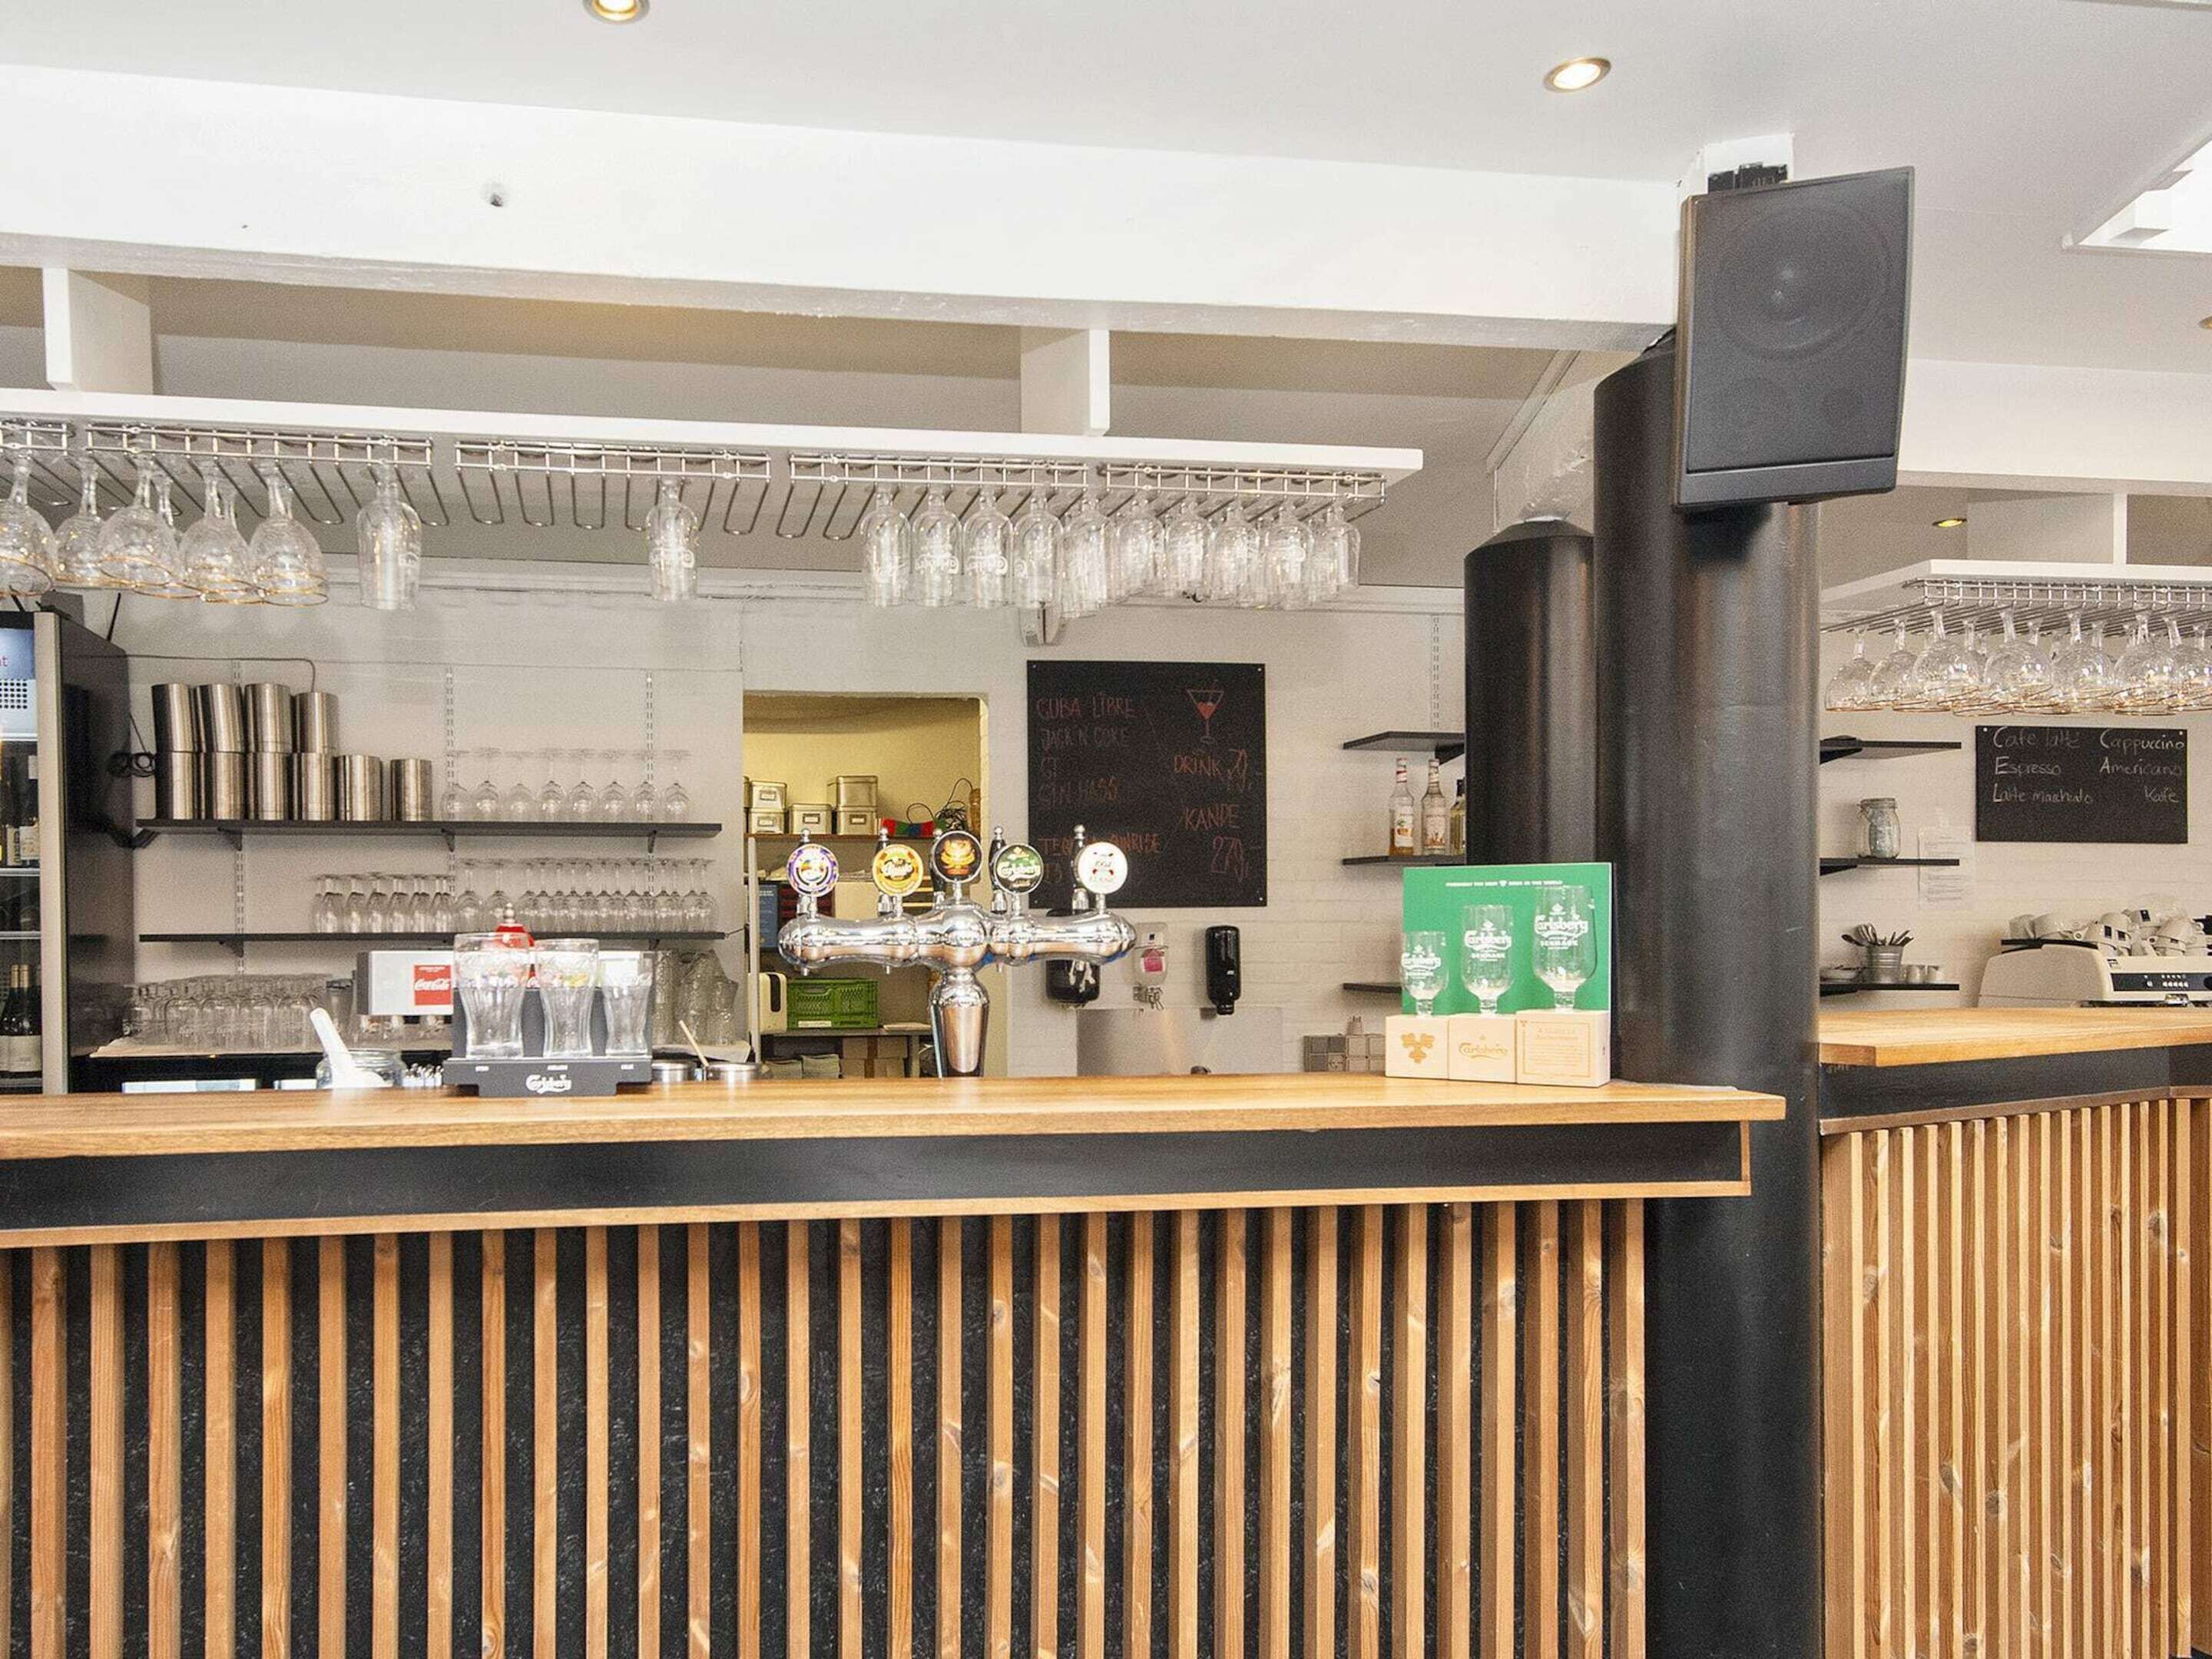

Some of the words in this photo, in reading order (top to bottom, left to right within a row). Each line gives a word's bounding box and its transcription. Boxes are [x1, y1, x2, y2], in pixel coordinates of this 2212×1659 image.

[1037, 697, 1081, 720] CUBA
[2100, 729, 2184, 755] Cappuccino
[1995, 756, 2061, 777] Espresso
[2100, 757, 2182, 775] Americano
